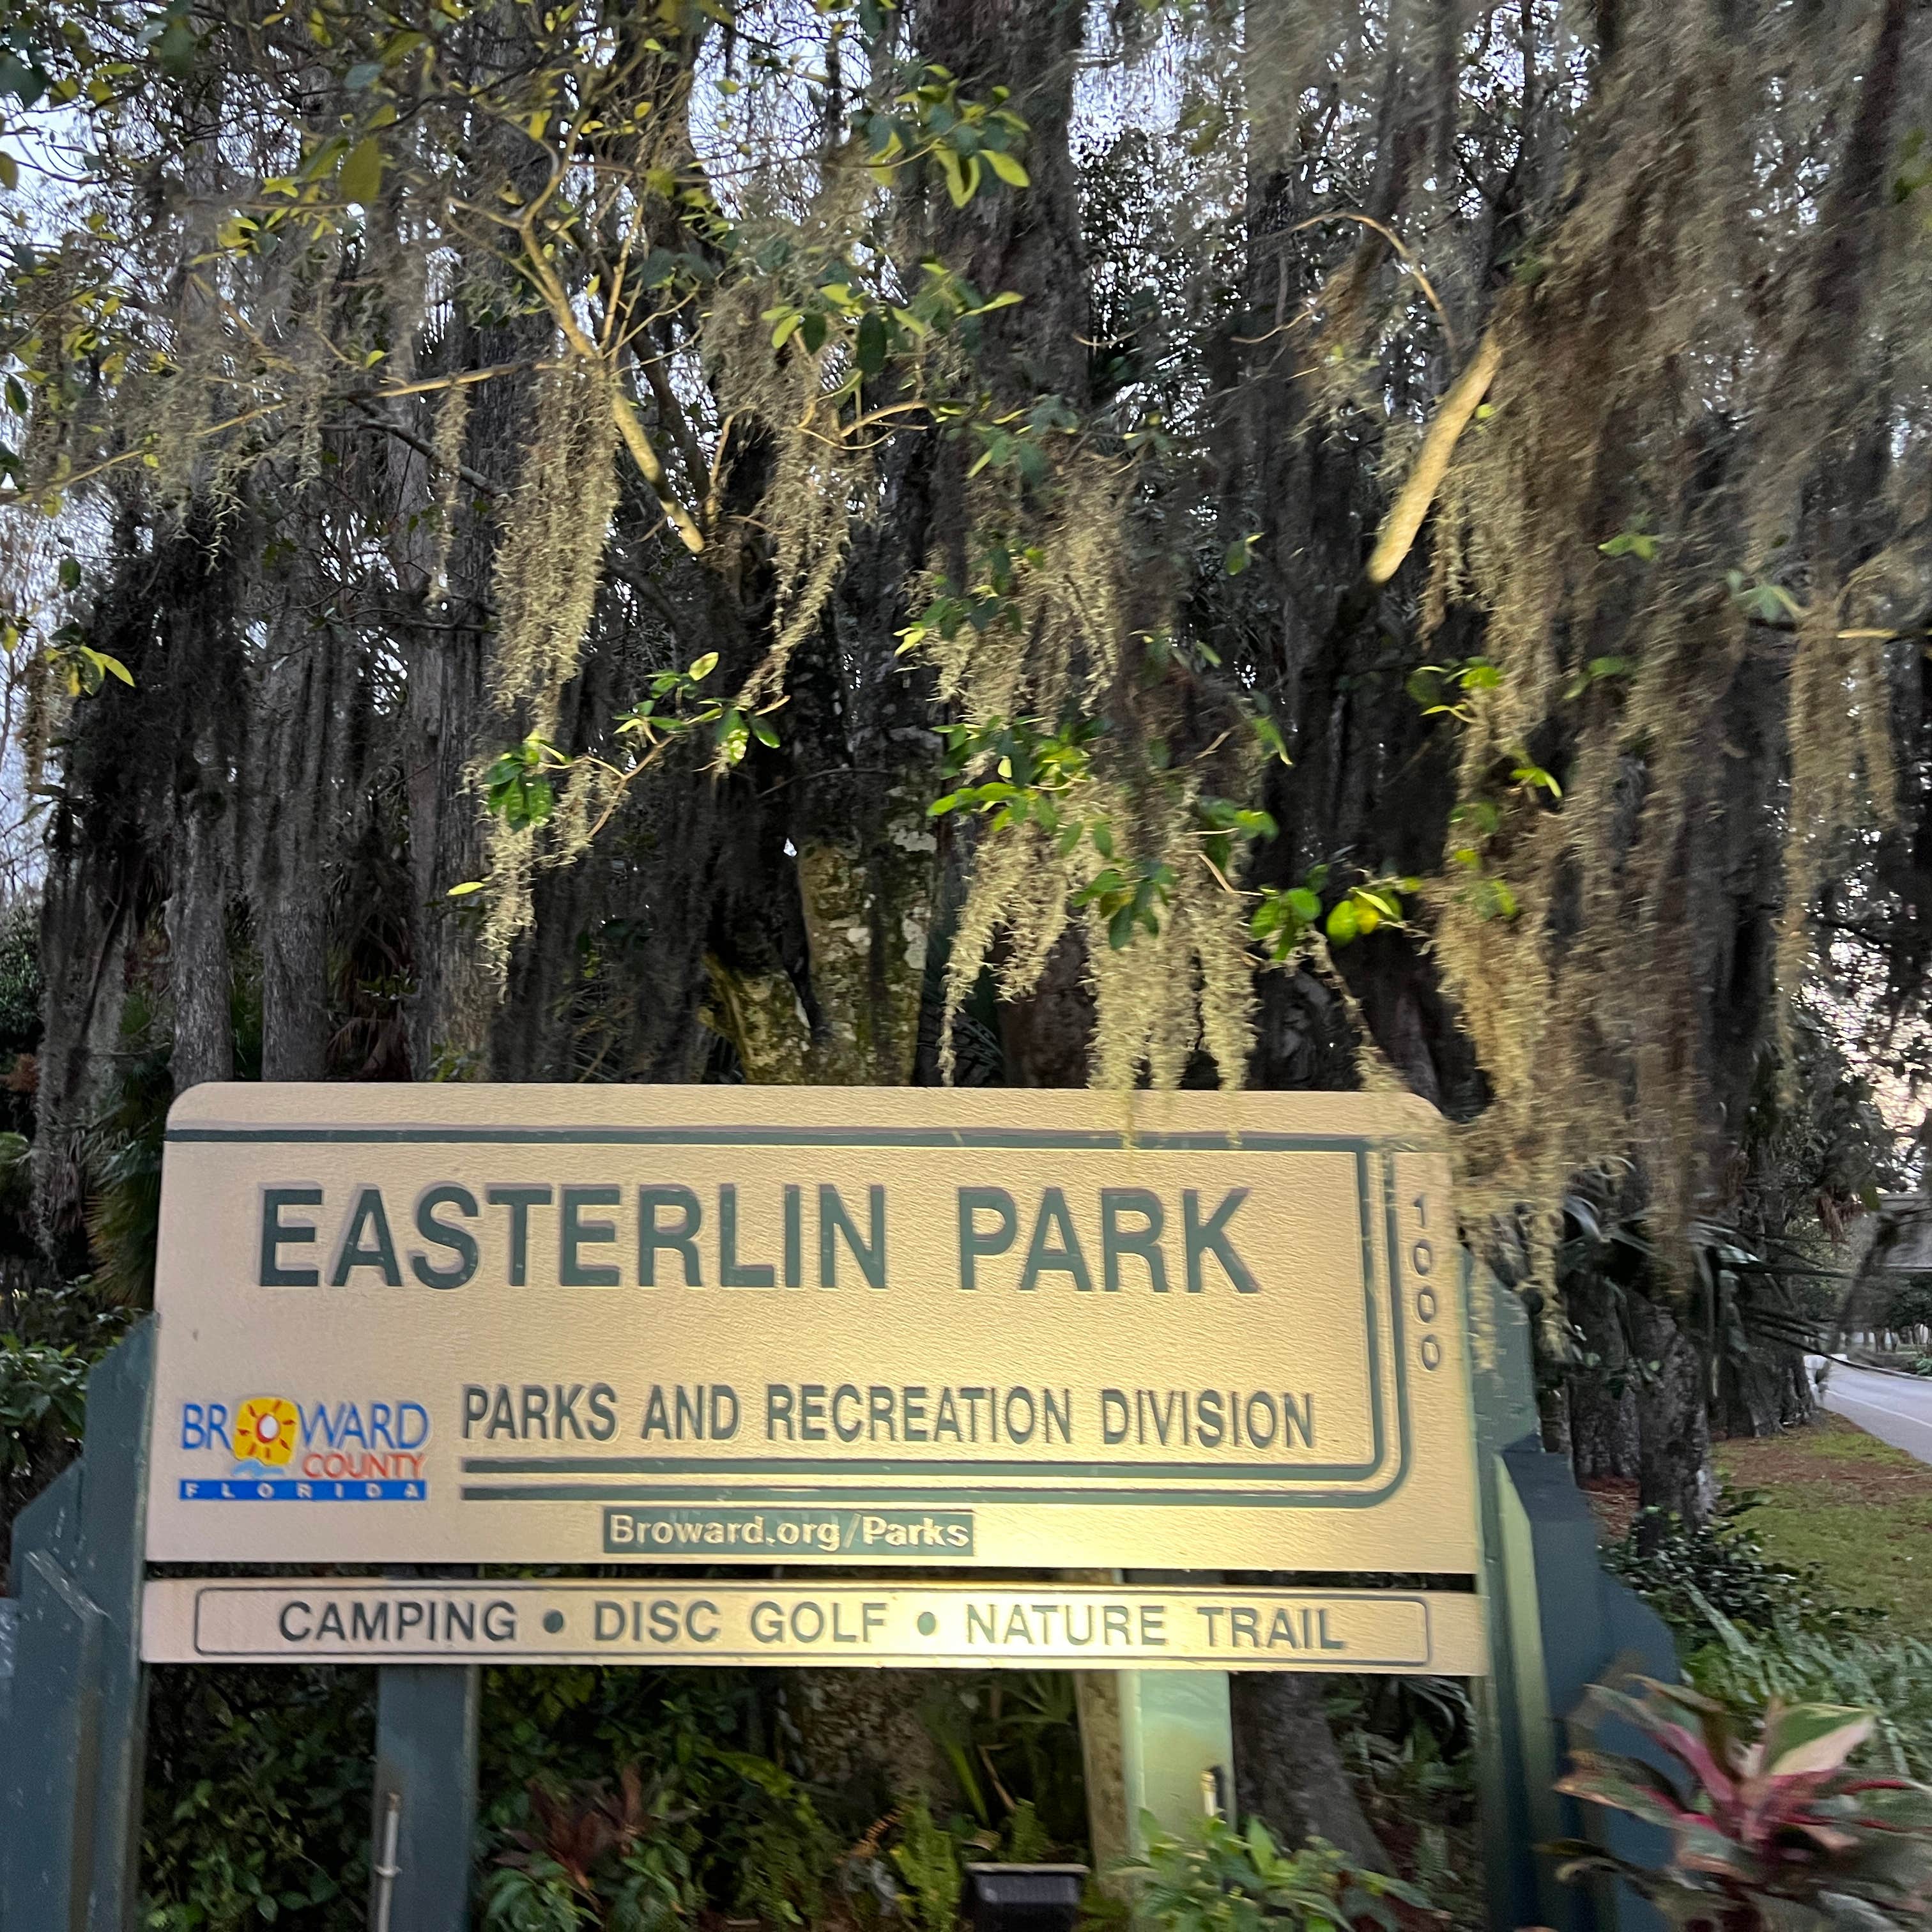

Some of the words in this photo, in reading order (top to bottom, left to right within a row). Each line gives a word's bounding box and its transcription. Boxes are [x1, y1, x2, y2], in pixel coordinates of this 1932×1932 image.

[258, 1182, 887, 1289] EASTERLIN
[958, 1186, 1259, 1294] PARK
[1413, 1193, 1440, 1371] 1000
[461, 1383, 617, 1442] PARKS
[641, 1384, 740, 1441] AND
[767, 1384, 1072, 1445] RECREATION
[1102, 1388, 1315, 1449] DIVISION
[185, 1482, 420, 1499] FLORIDA
[302, 1452, 426, 1479] COUNTY
[609, 1514, 970, 1551] Broward.org/Parks
[278, 1599, 516, 1643] CAMPING
[594, 1600, 720, 1643] DISC
[749, 1600, 888, 1643] GOLF
[966, 1603, 1168, 1646] NATURE
[1197, 1606, 1346, 1650] TRAIL
